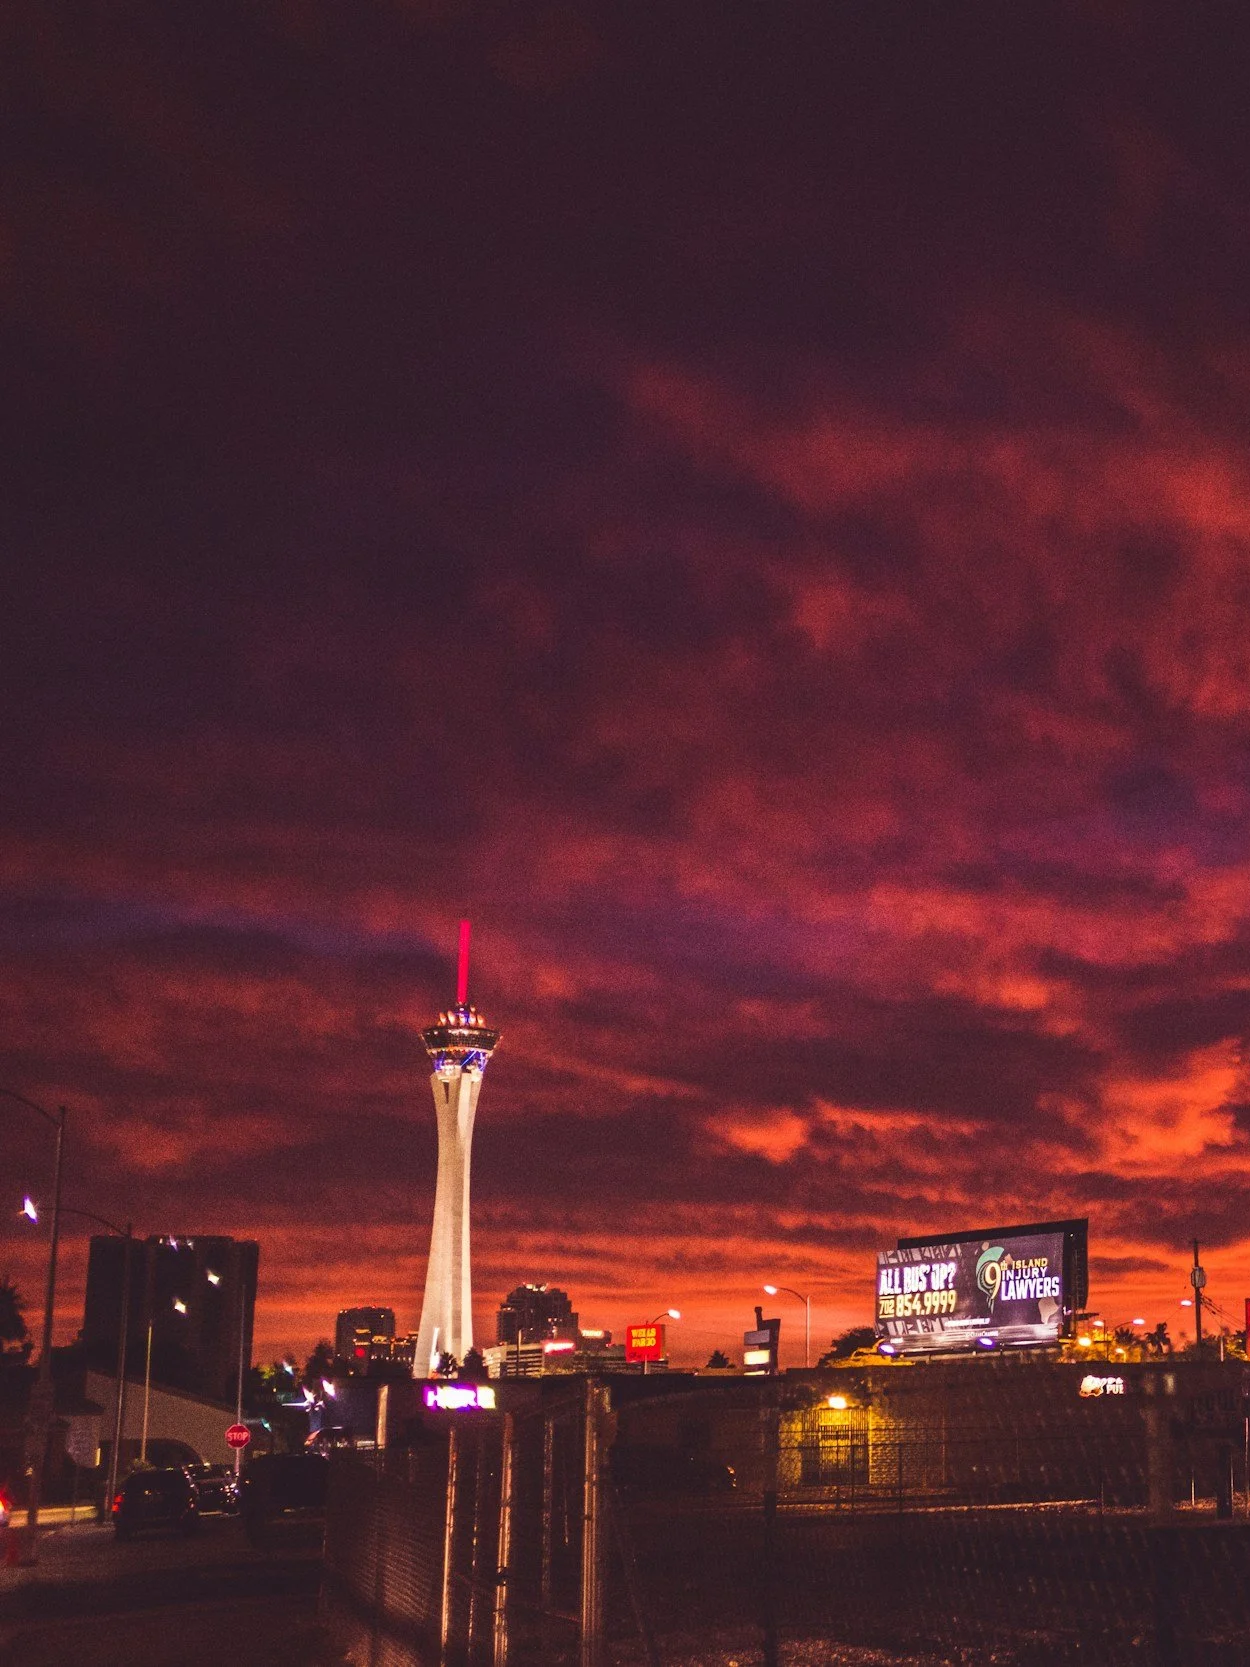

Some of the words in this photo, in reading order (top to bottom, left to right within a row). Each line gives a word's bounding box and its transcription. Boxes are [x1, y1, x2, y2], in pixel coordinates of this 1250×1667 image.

[1012, 1257, 1048, 1269] ISLAND
[1001, 1266, 1048, 1281] INJURY
[879, 1267, 902, 1295] ALL
[1001, 1276, 1060, 1301] LAWYERS
[879, 1299, 895, 1315] 702
[895, 1289, 956, 1317] 854.9999
[631, 1328, 656, 1338] WELLS
[631, 1337, 656, 1348] FARGO
[227, 1432, 249, 1441] STOP
